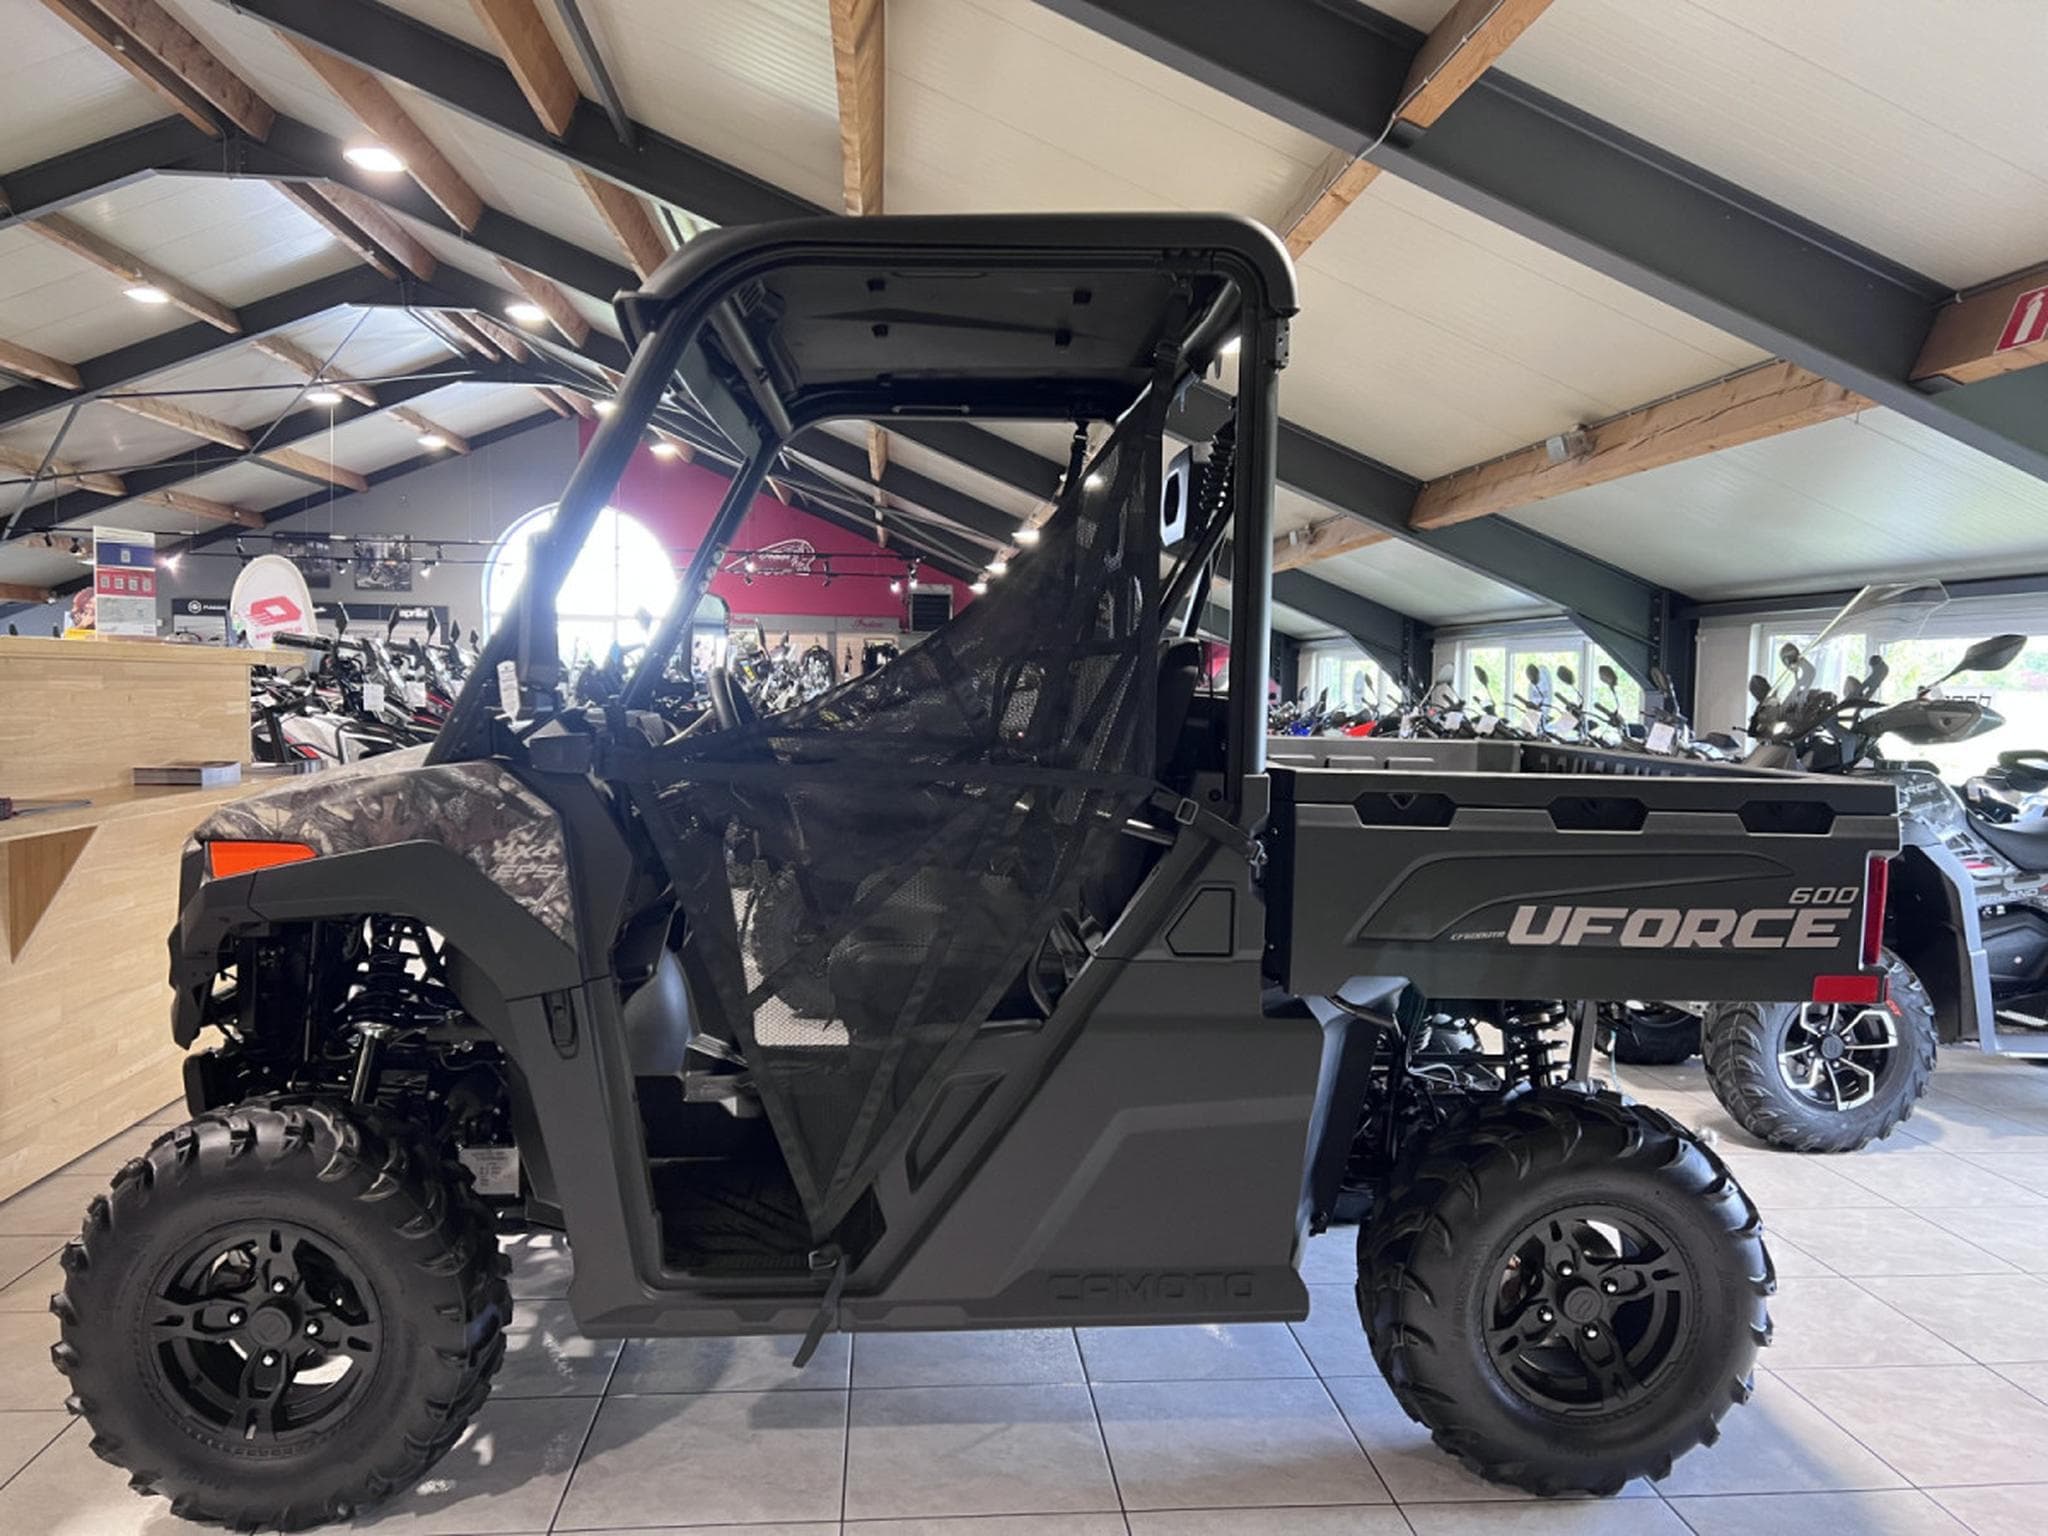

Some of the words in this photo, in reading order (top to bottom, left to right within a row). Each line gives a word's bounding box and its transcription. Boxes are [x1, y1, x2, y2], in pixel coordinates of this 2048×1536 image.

[494, 863, 559, 879] EPS
[1788, 886, 1860, 905] 600
[1507, 905, 1852, 948] UFORCE
